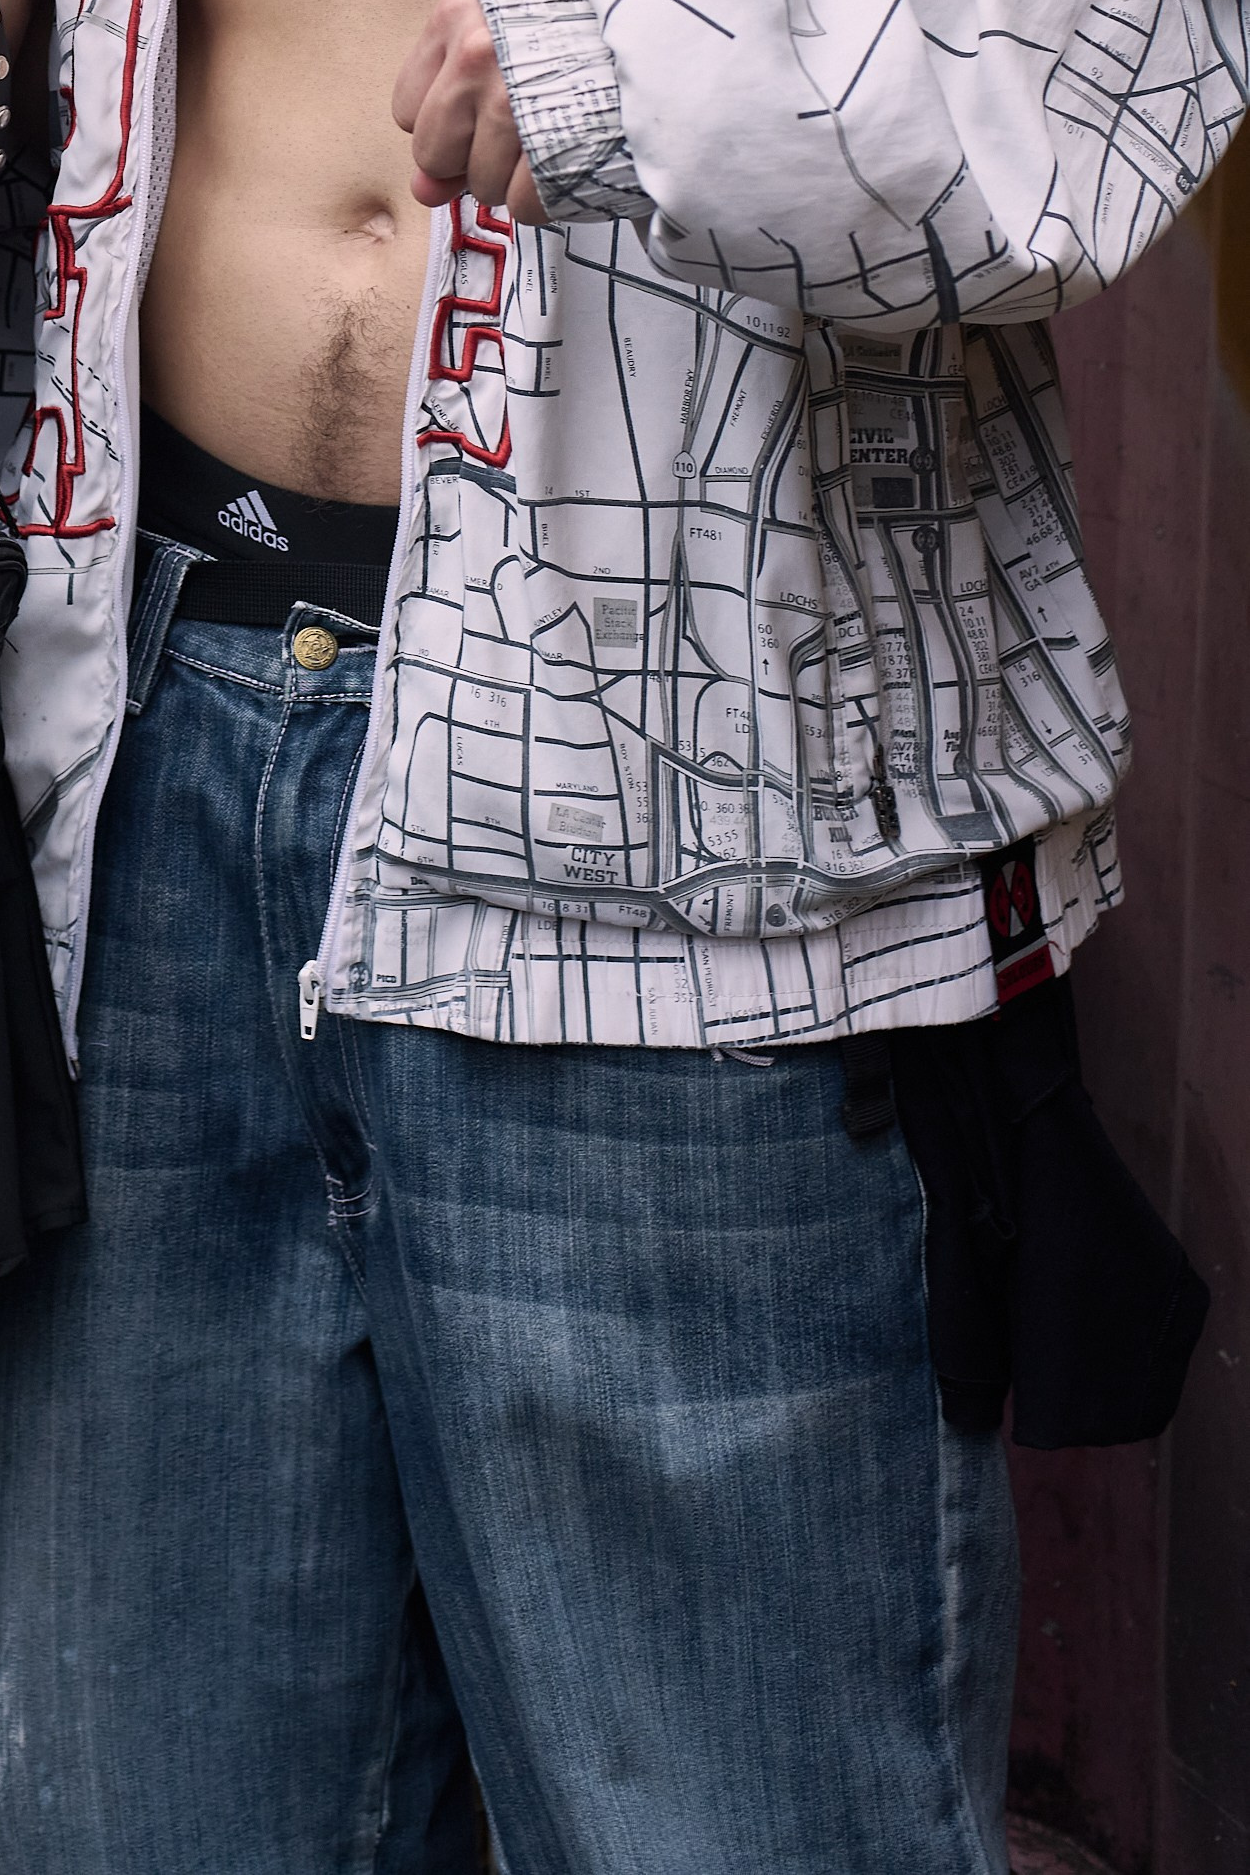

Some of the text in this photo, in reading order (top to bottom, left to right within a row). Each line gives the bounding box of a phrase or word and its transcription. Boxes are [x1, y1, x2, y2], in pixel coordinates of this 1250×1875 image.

[1090, 67, 1104, 81] 92
[1140, 108, 1169, 136] BOSTON
[460, 249, 469, 285] OUGLAS
[777, 326, 790, 339] 92
[623, 337, 637, 378] BEAUDRY
[730, 389, 747, 427] FREMONT
[850, 448, 909, 464] ENTER
[675, 462, 693, 473] 110
[715, 466, 748, 474] DIAMOND
[217, 510, 289, 552] adidas
[690, 527, 722, 541] FT481
[465, 576, 503, 591] EMERAD
[960, 580, 987, 593] LDCH
[780, 592, 818, 610] LDCHS
[757, 624, 773, 635] 60
[761, 638, 779, 649] 360
[1013, 661, 1027, 674] 16
[1021, 672, 1040, 687] 316
[489, 689, 507, 706] 316
[456, 735, 464, 766] LUCAS
[555, 782, 599, 793] MARYLAND
[571, 846, 616, 867] CITY
[563, 864, 619, 885] WEST
[724, 890, 735, 932] FREMONT
